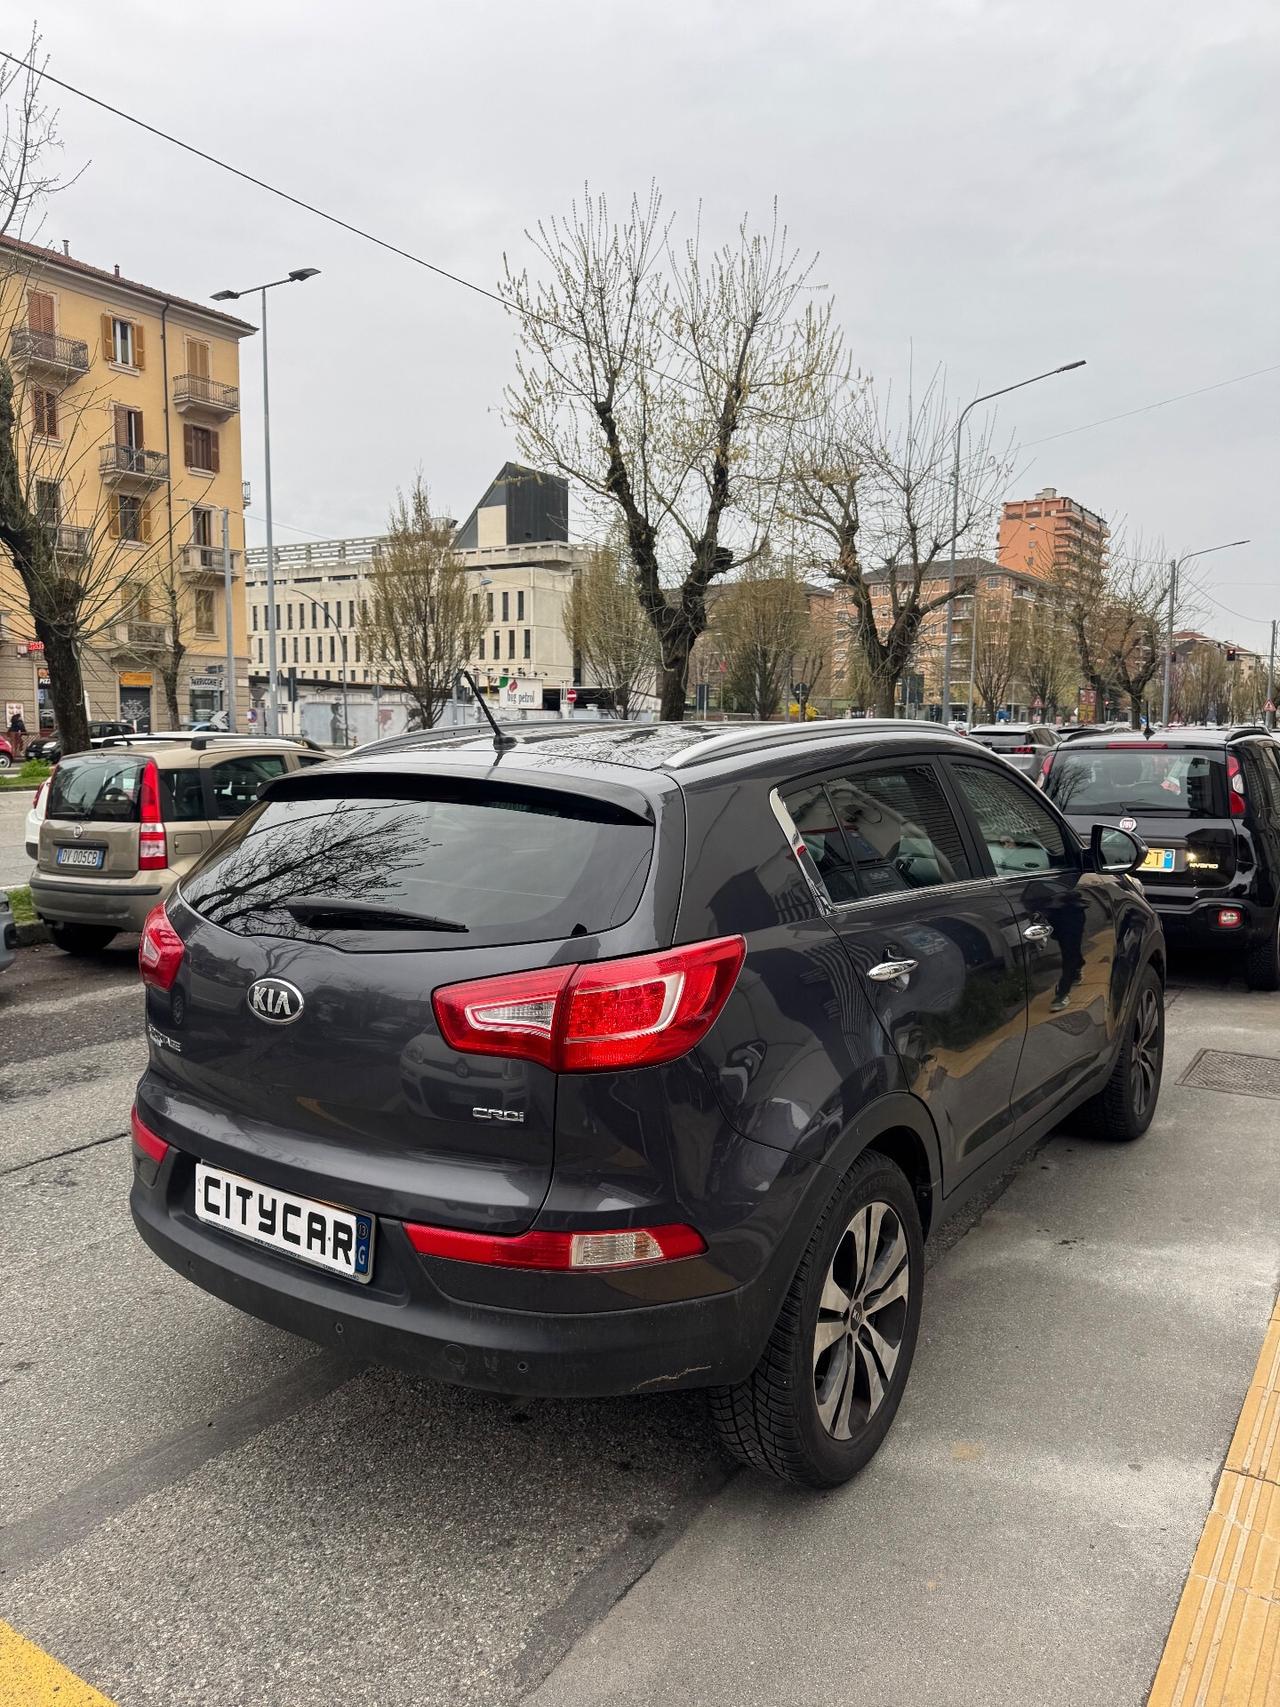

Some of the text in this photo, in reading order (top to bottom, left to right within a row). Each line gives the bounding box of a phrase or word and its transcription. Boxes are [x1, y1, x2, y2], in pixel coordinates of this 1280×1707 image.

[1143, 851, 1162, 865] CT
[253, 985, 292, 1015] KIA
[204, 1175, 353, 1266] CITYCAR
